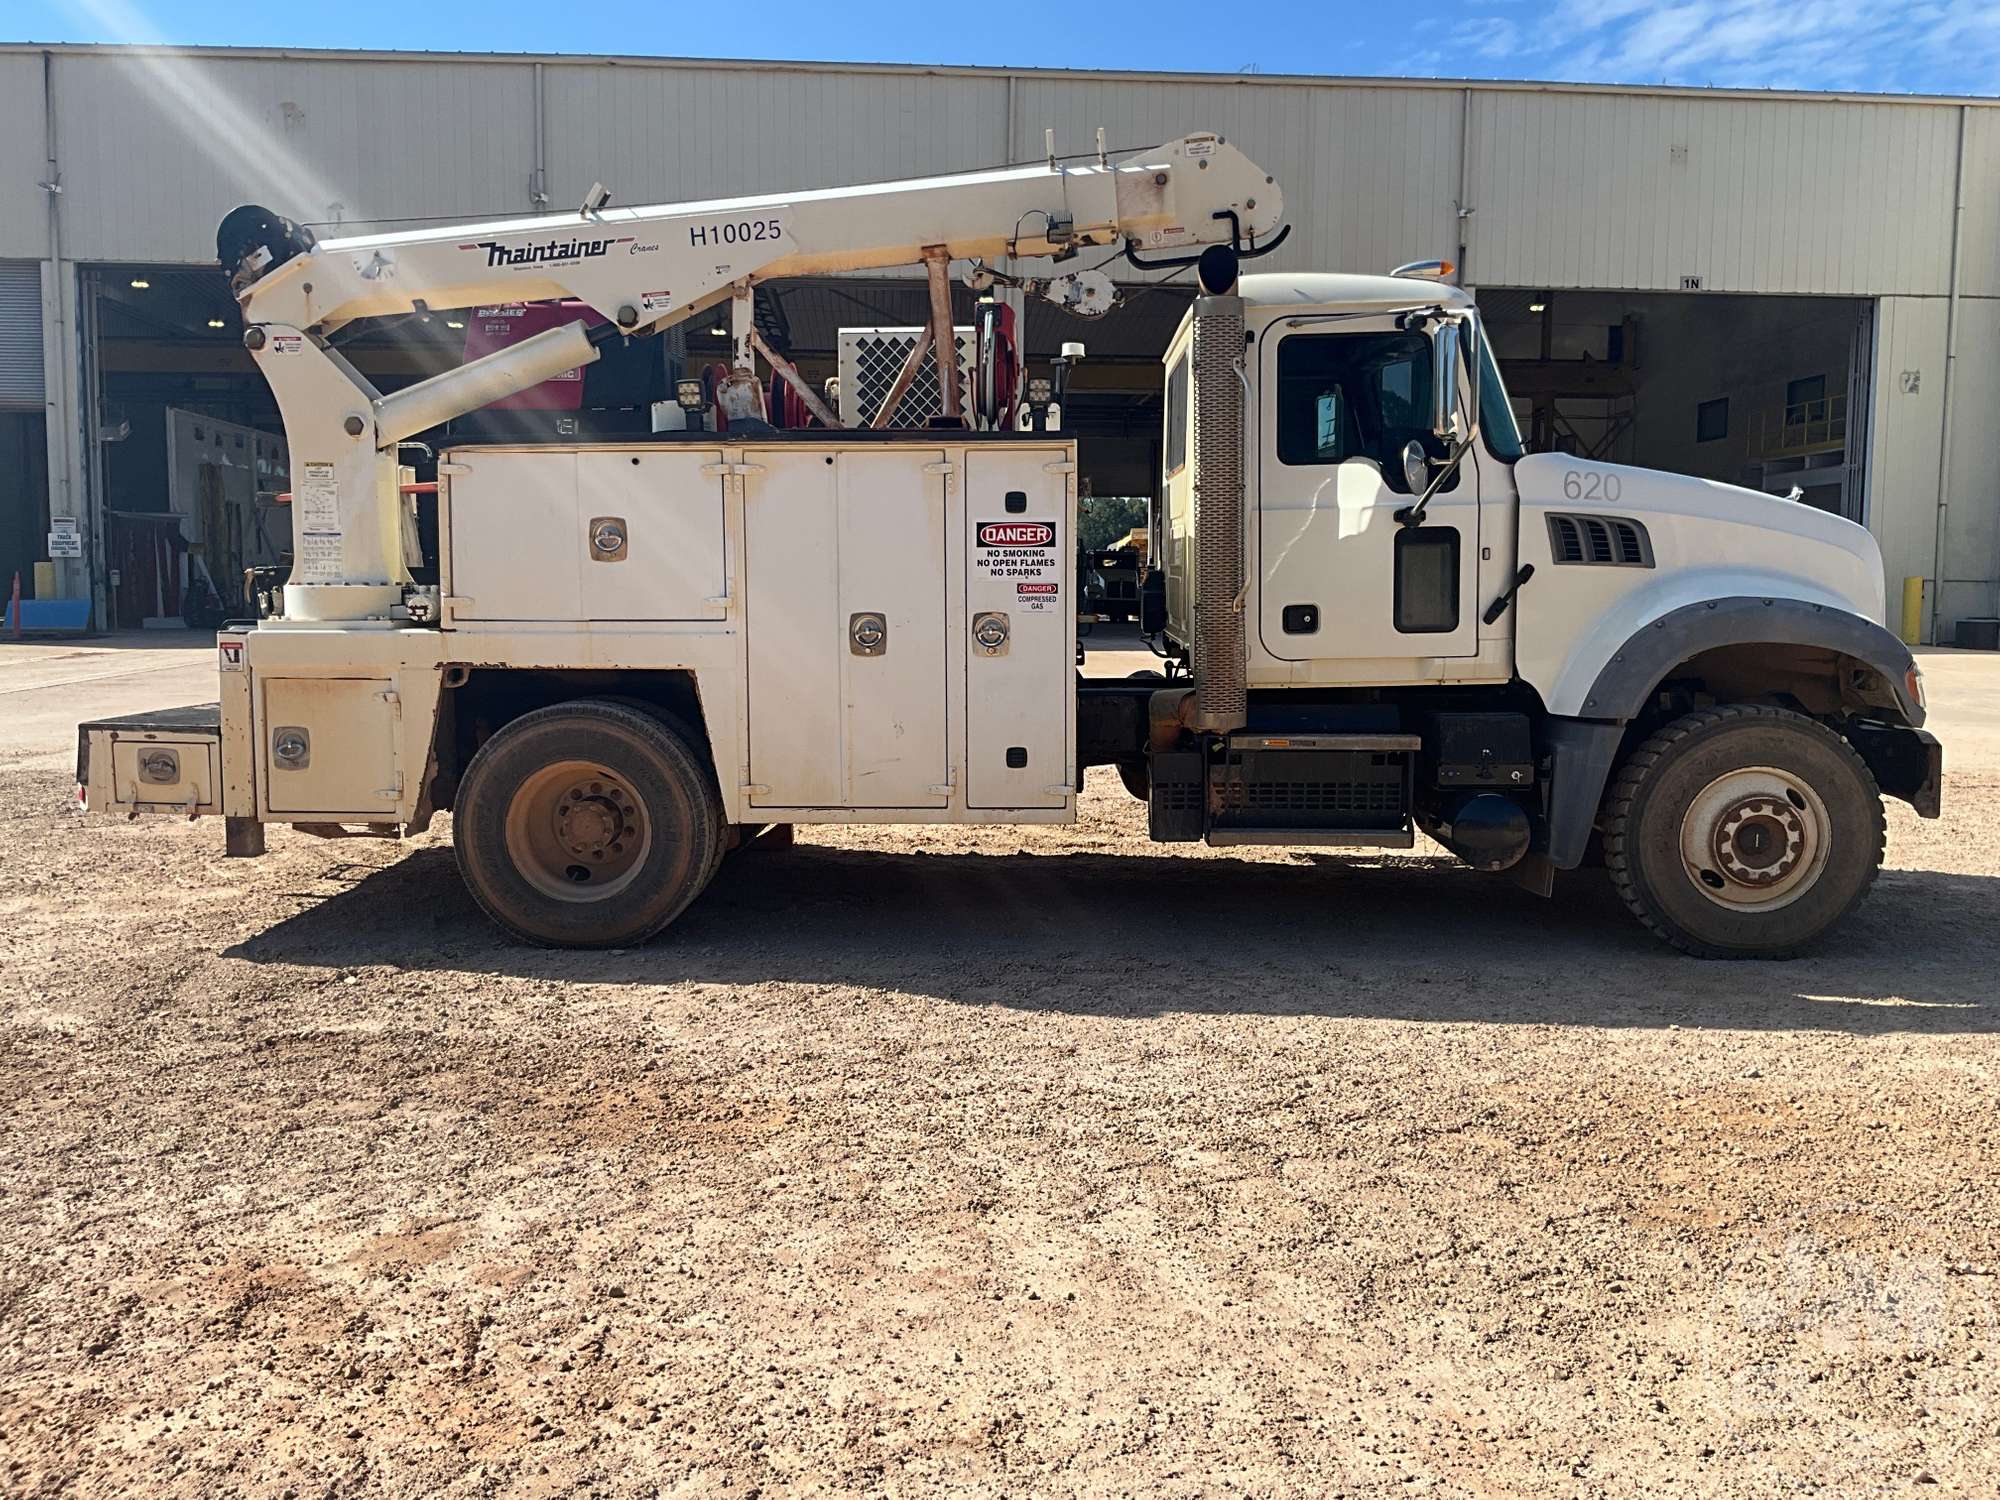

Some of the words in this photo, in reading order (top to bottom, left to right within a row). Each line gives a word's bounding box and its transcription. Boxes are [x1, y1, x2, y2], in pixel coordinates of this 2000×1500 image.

[690, 220, 781, 246] H10025
[478, 238, 616, 267] Maintainer
[1684, 278, 1699, 289] 1N
[1563, 470, 1622, 502] 620
[985, 527, 1047, 541] DANGER
[987, 549, 1000, 557] NO
[1003, 549, 1045, 557] SMOKING
[977, 559, 990, 567] NO
[993, 559, 1017, 567] OPEN
[1020, 559, 1056, 567] FLAMES
[991, 568, 1003, 576] NO
[1006, 568, 1042, 576] SPARKS
[1018, 595, 1057, 603] COMPRESSED
